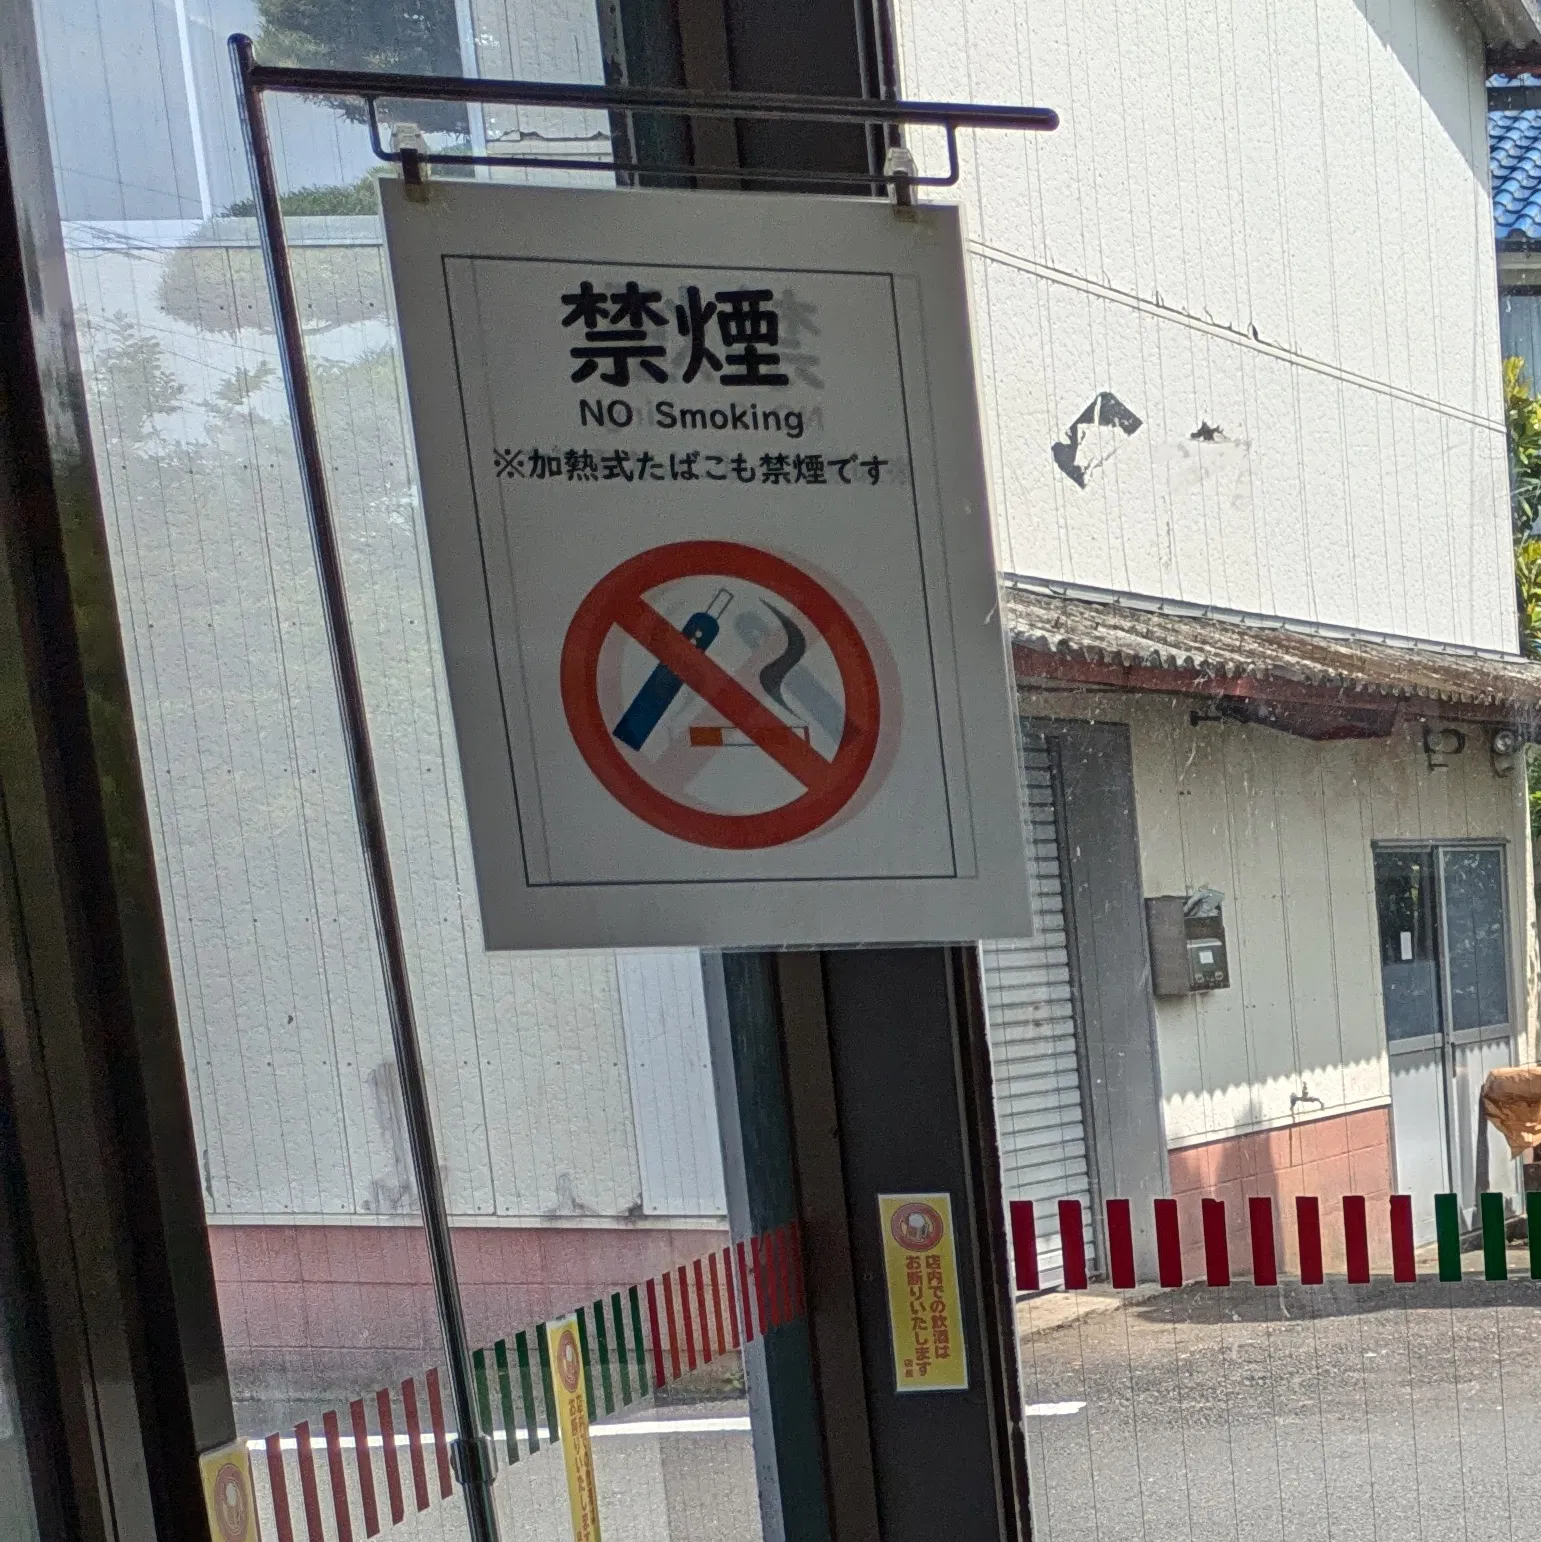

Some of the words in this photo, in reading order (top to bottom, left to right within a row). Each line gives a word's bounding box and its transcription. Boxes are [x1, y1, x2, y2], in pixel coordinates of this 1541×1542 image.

[561, 281, 789, 388] 禁煙
[494, 447, 889, 486] ※加熱式たばこも禁煙です
[580, 399, 634, 429] NO
[656, 401, 803, 437] Smoking
[905, 1255, 931, 1377] お断りいたします
[925, 1254, 951, 1360] 店内での飲酒は
